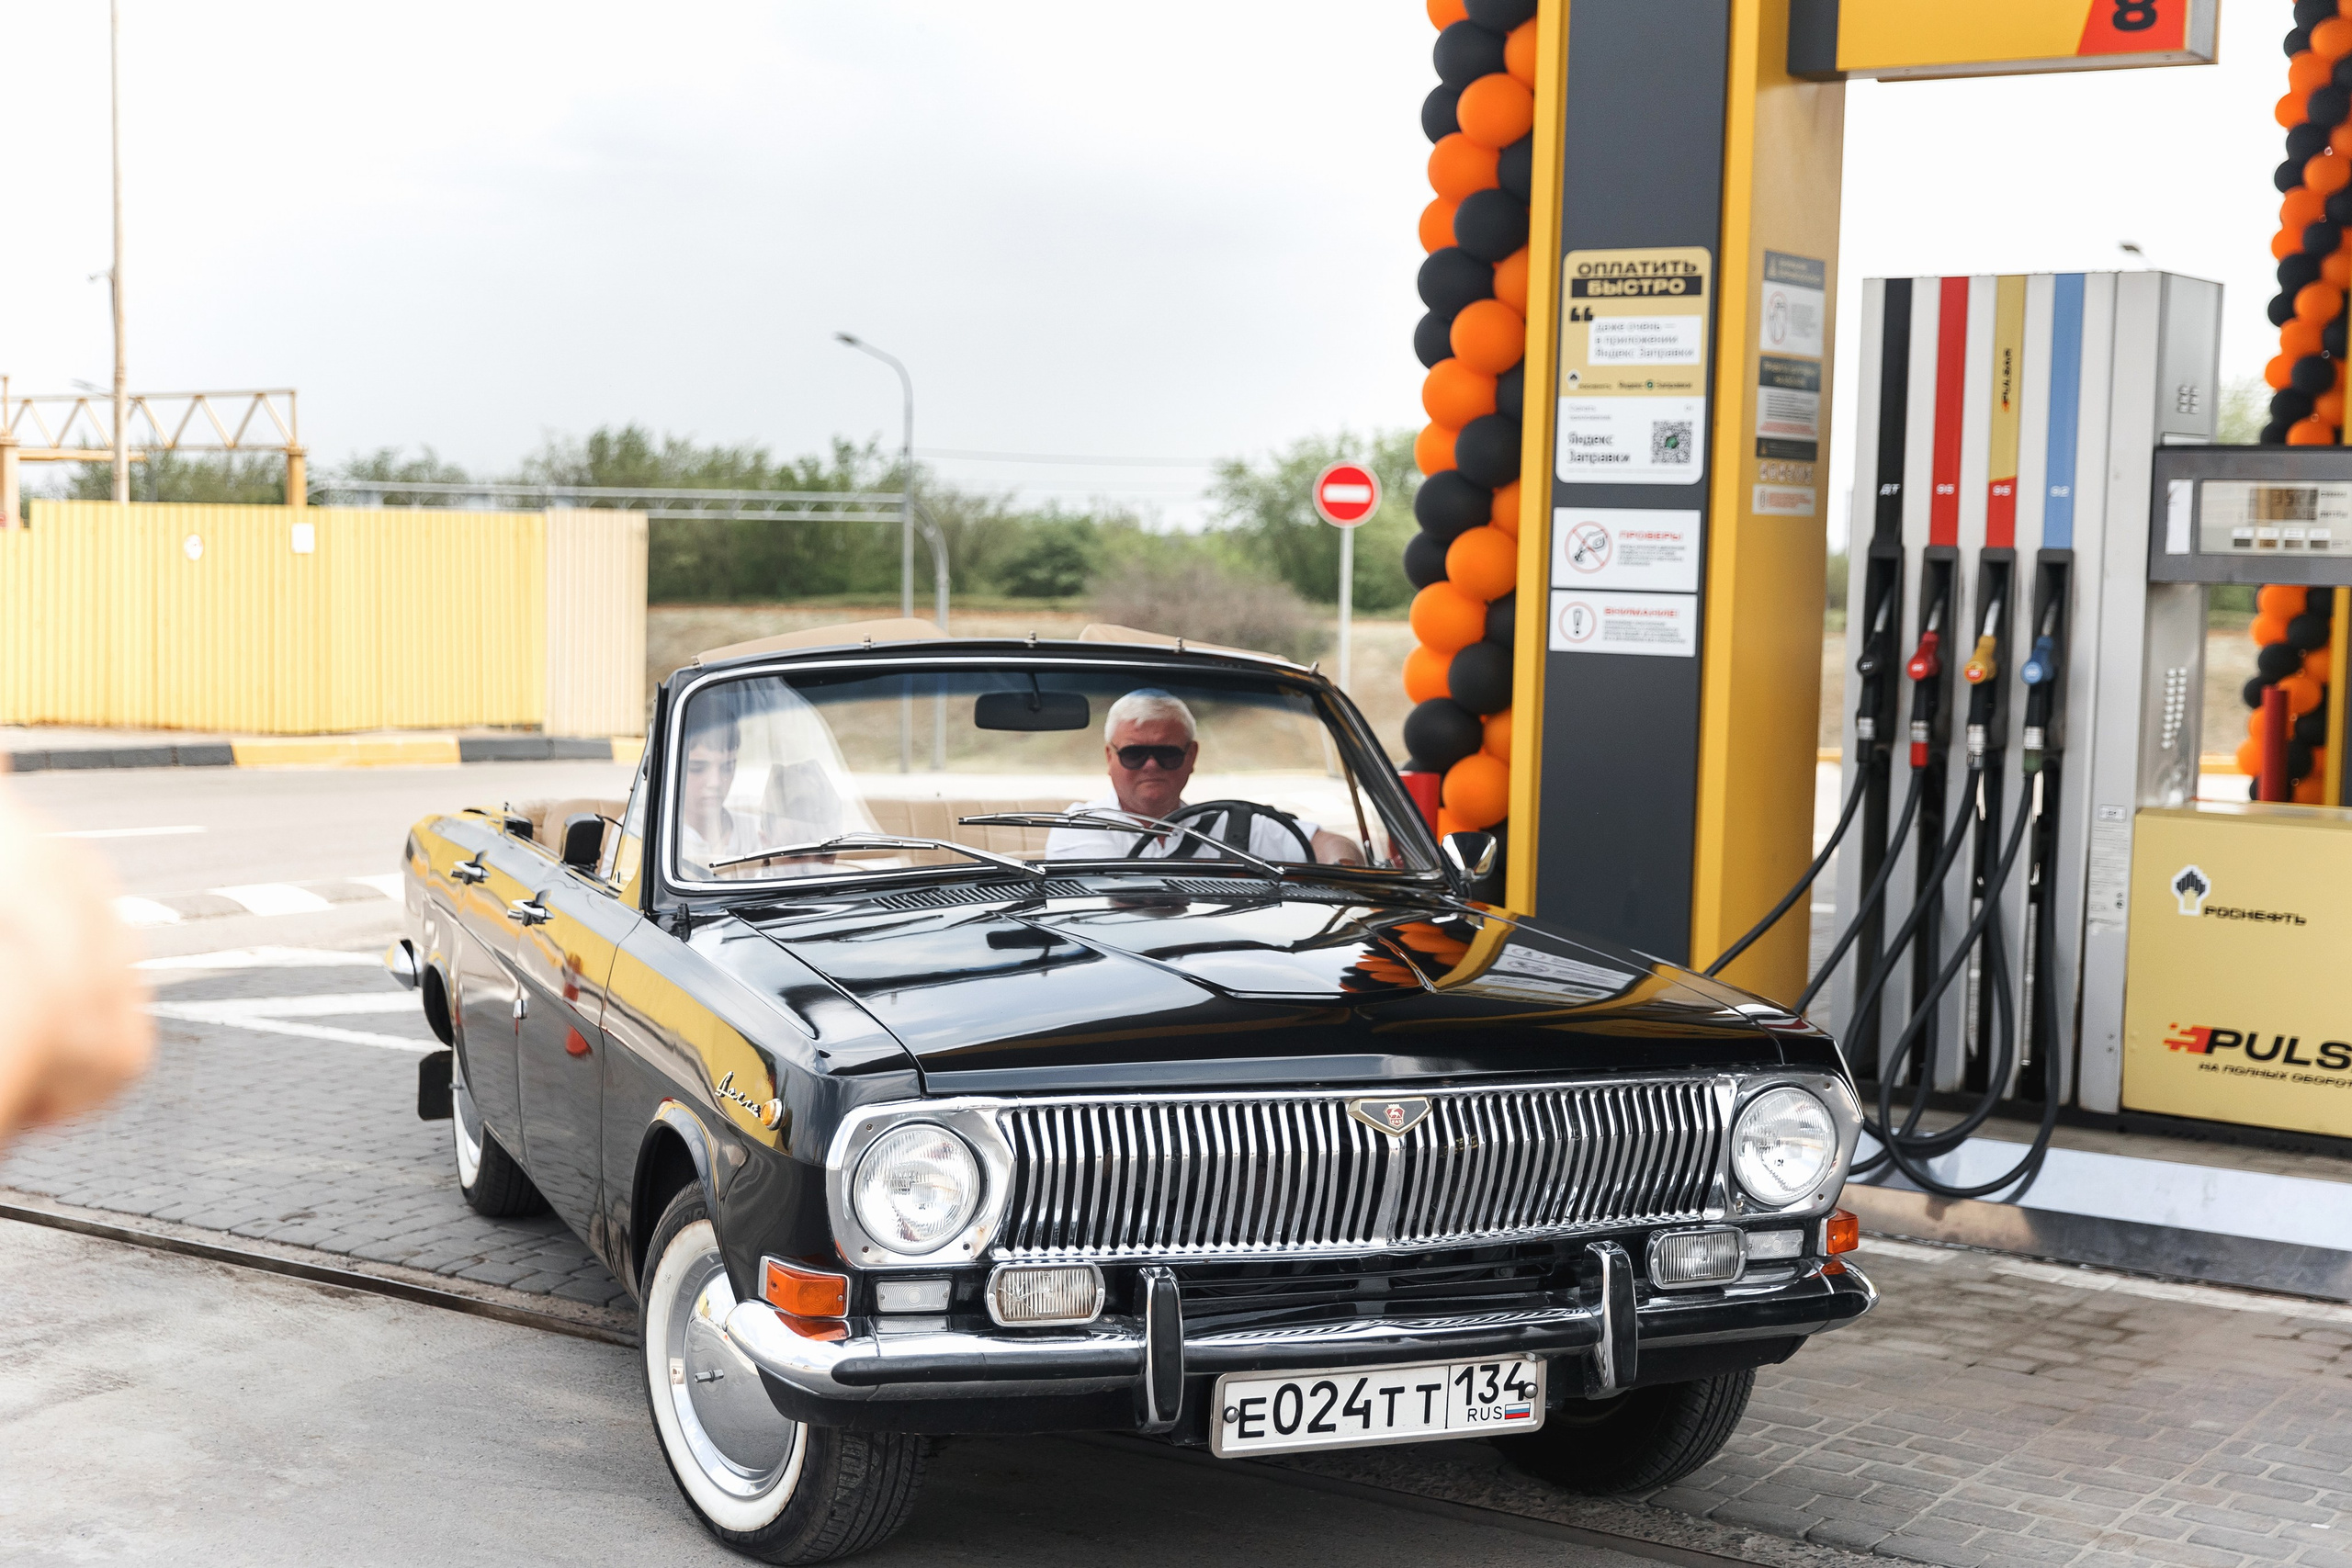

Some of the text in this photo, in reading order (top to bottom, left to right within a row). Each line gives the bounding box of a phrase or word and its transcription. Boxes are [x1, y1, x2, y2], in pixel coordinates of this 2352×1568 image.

[1577, 260, 1698, 276] ОПЛАТИТЬ
[1587, 277, 1687, 296] БЫСТРО
[1568, 432, 1614, 446] Яндекс
[1568, 450, 1631, 465] Заправки
[1936, 483, 1955, 495] 95
[1992, 485, 2012, 496] 95
[2050, 485, 2071, 497] 92
[2203, 905, 2308, 926] РОСНЕФТЬ
[2205, 1027, 2352, 1070] PULS
[2223, 1065, 2289, 1081] ПОЛНЫХ
[1238, 1361, 1527, 1439] Е024ТТ 134
[1467, 1404, 1503, 1423] RUS
